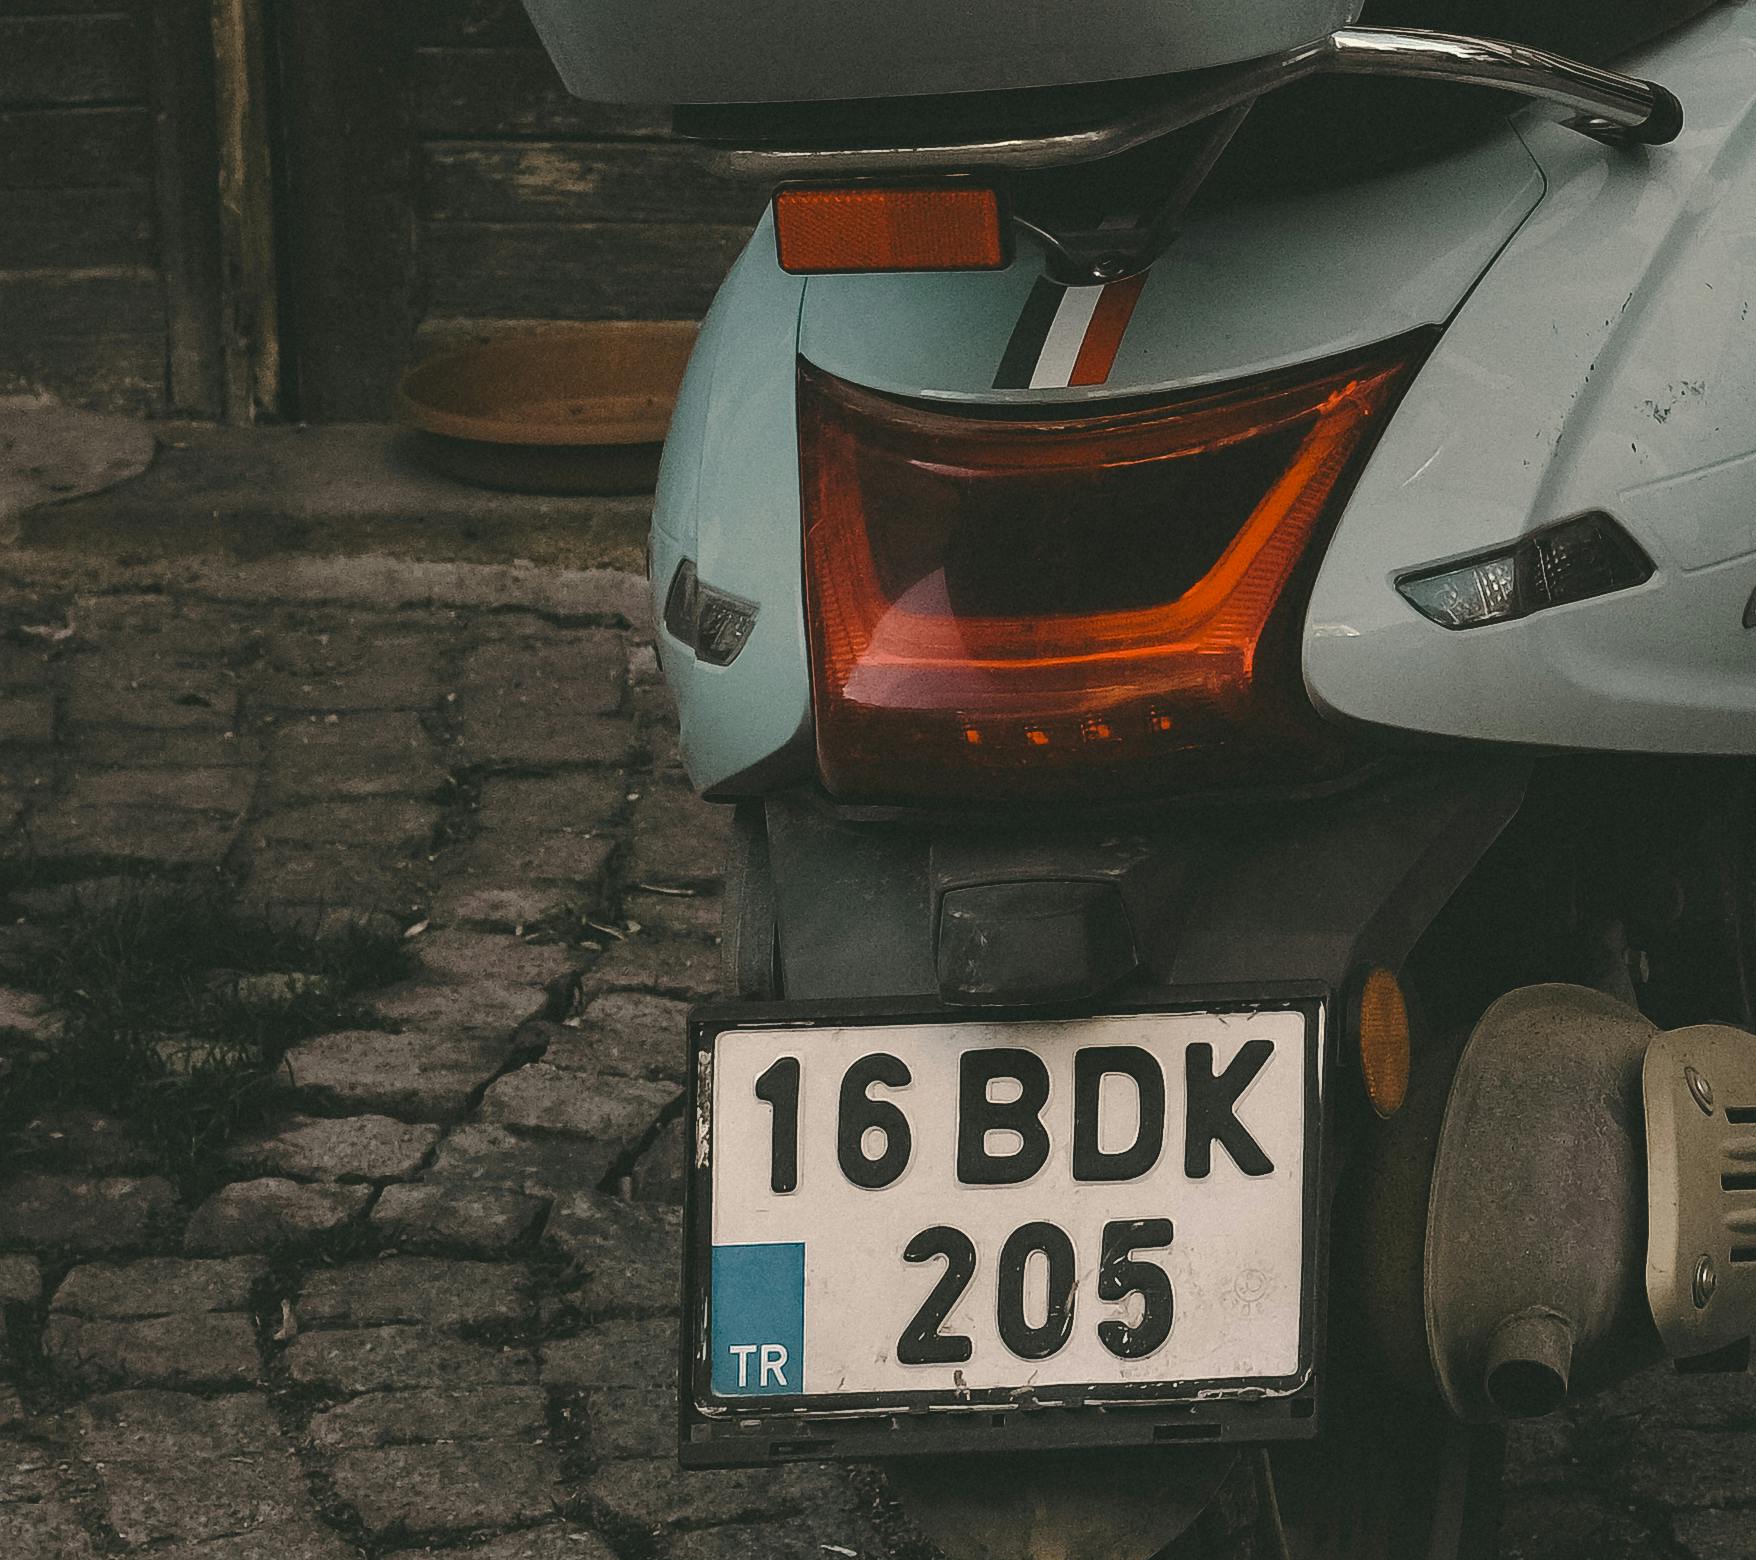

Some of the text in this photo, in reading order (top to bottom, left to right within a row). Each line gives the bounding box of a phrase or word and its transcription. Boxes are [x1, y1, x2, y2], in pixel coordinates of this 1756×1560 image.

[755, 1039, 1276, 1194] 16 BDK
[729, 1344, 788, 1388] TR
[896, 1218, 1175, 1366] 205
